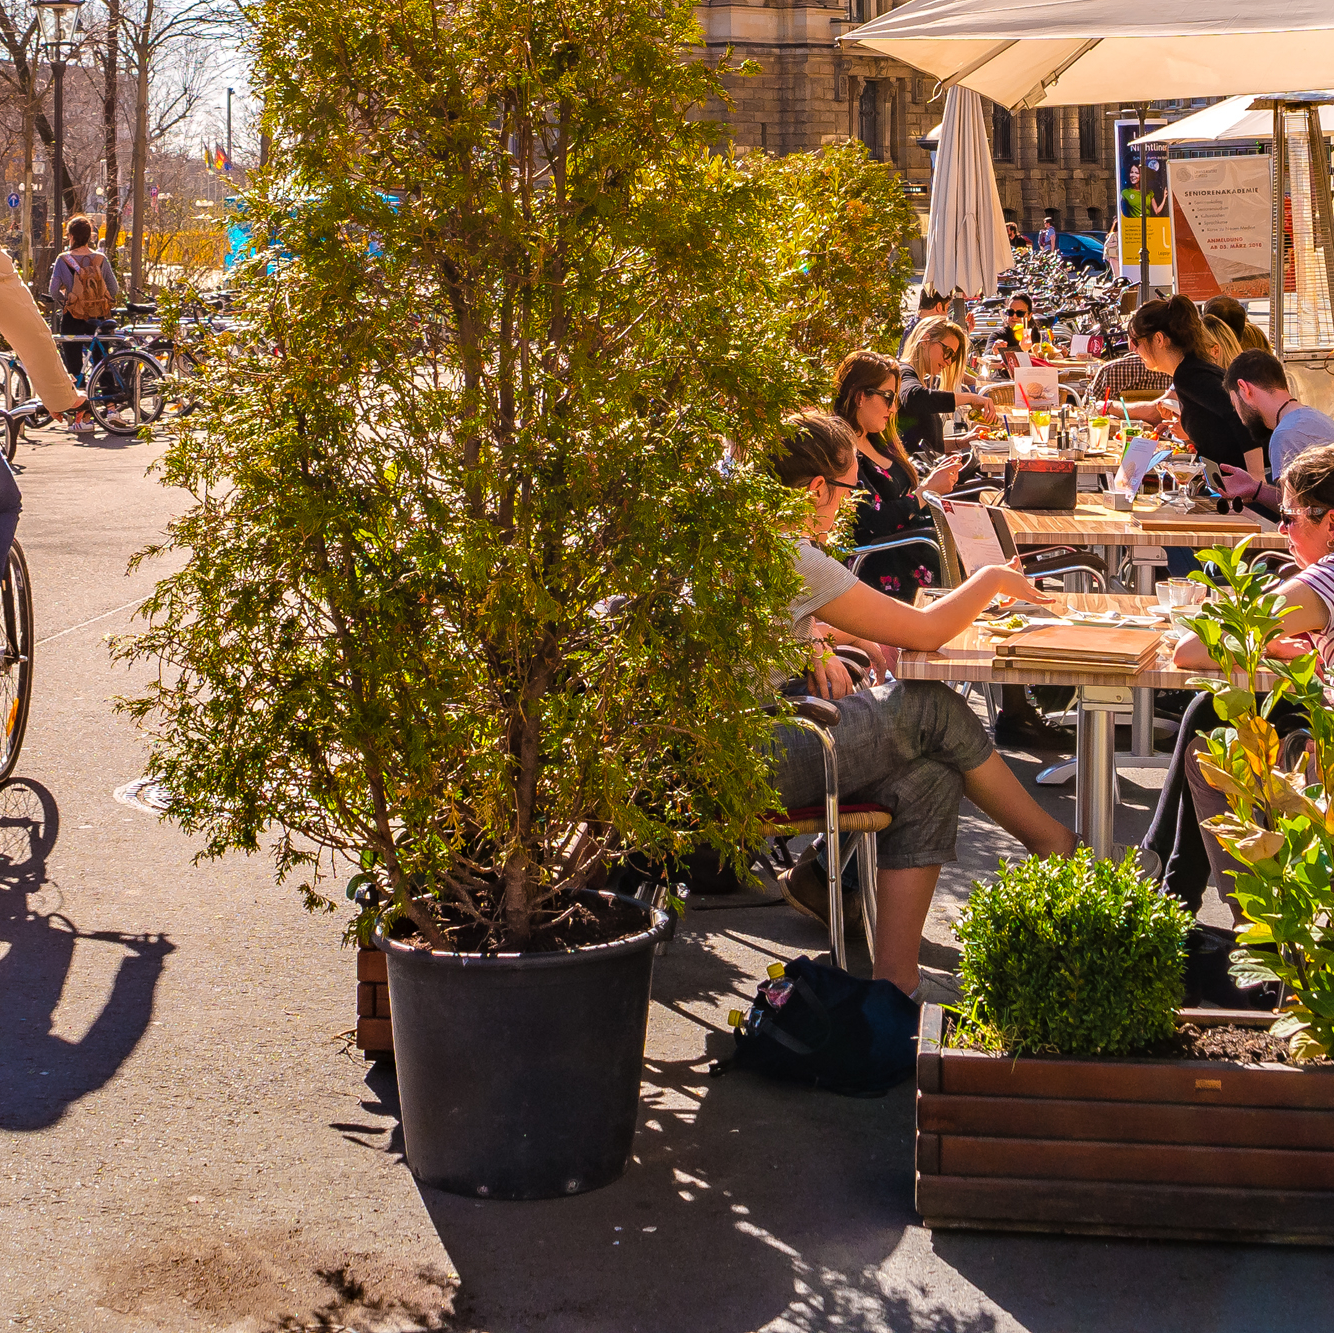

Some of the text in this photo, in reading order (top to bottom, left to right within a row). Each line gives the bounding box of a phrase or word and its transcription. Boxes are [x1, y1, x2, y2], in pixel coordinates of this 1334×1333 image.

[1130, 143, 1168, 152] Nihtliner
[1184, 187, 1259, 197] SENIORENAKADEMIE
[1207, 236, 1244, 244] ANMELDUNG
